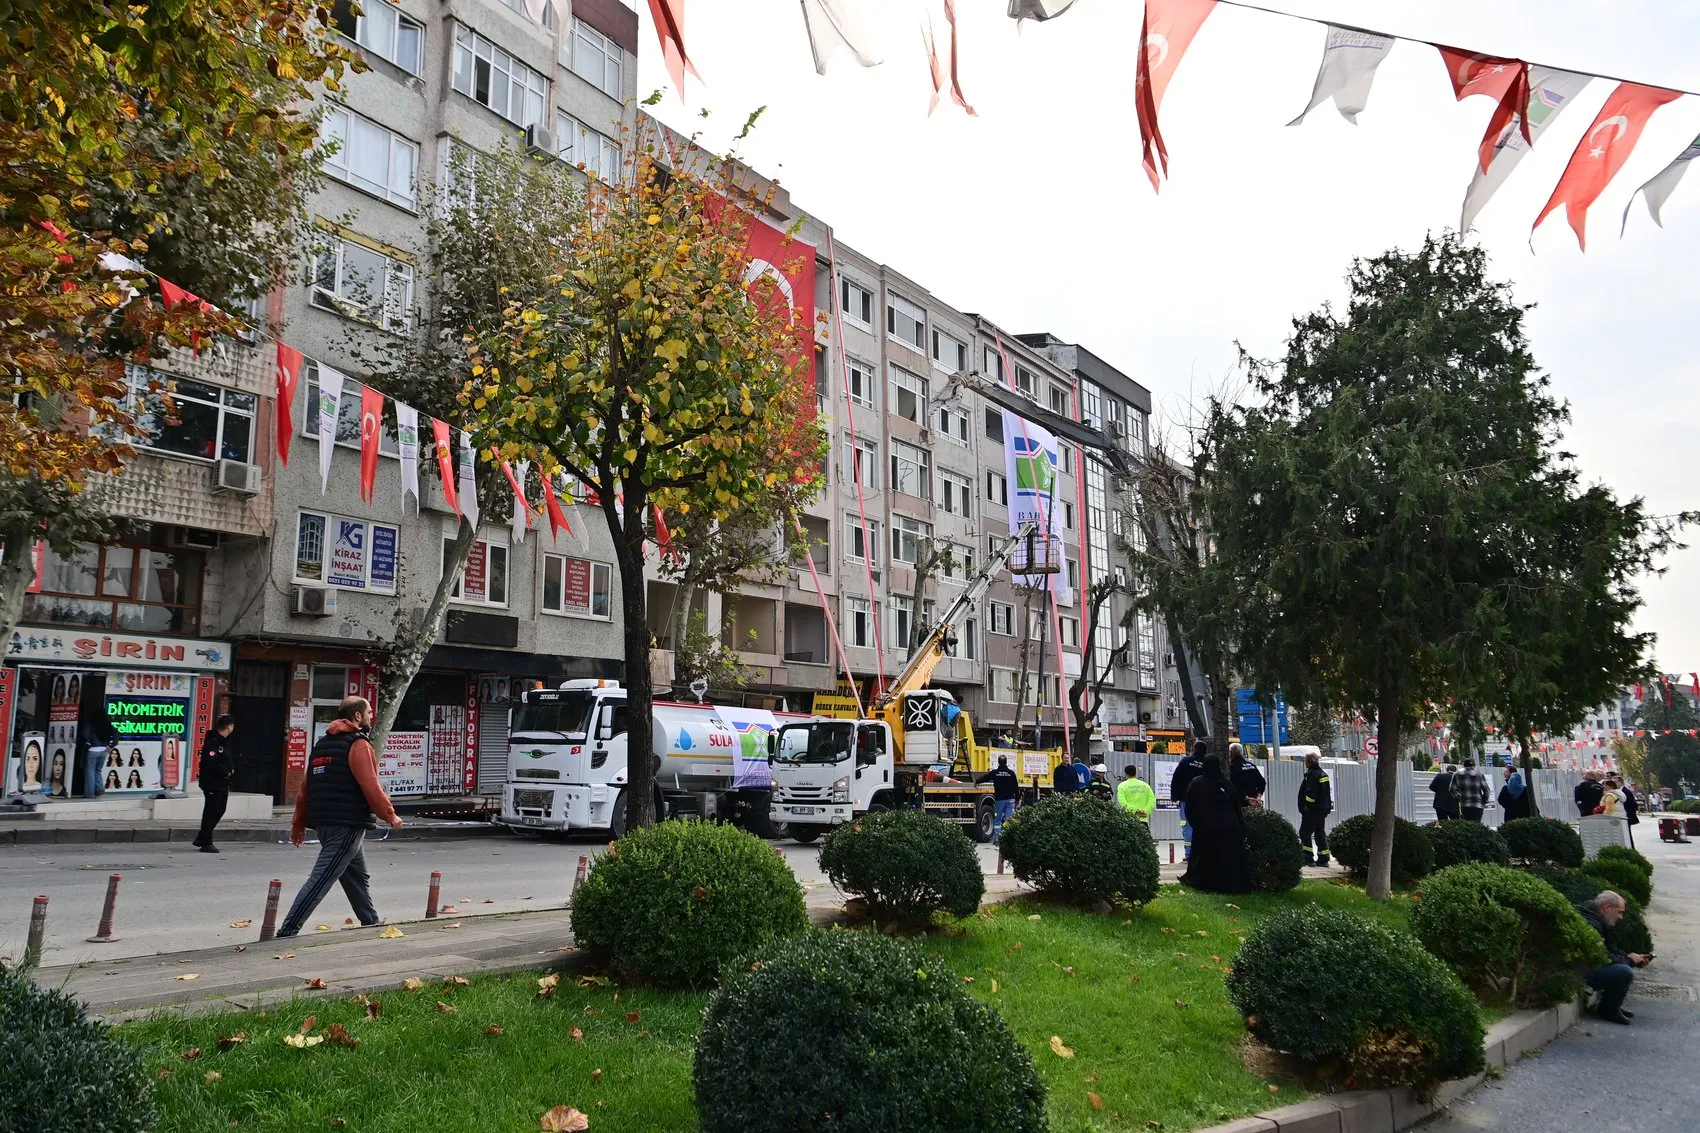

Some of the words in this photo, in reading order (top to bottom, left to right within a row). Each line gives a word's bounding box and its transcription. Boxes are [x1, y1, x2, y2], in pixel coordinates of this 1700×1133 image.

[335, 548, 362, 560] KİRAZ
[331, 559, 364, 572] İNŞAAT
[72, 636, 185, 661] ŞİRİN
[107, 701, 185, 717] BİYOMETRİK
[157, 722, 185, 734] FOTO
[465, 684, 477, 783] FOTOĞRAF
